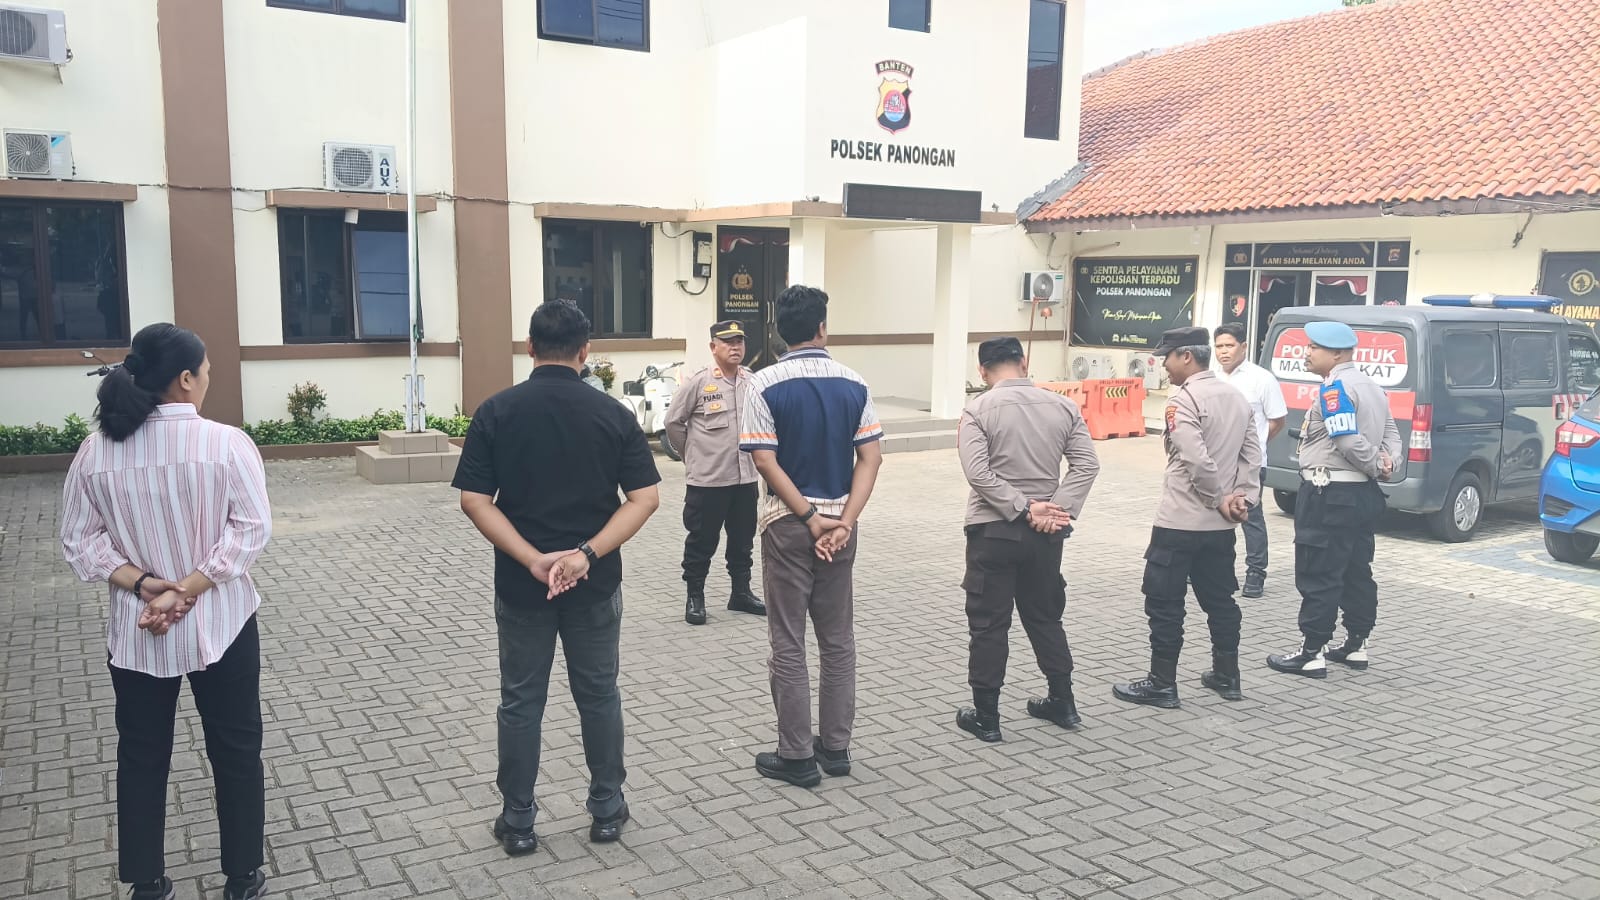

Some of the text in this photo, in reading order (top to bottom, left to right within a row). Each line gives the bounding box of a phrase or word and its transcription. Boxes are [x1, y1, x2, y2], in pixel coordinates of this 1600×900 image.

[879, 61, 912, 76] BANTEN
[831, 139, 956, 168] POLSEK PANONGAN
[380, 158, 390, 187] AUX
[1263, 257, 1366, 265] KAMI SIAP MELAYANI ANDA
[1093, 265, 1178, 275] SENTRA PELAYANAN
[1090, 275, 1180, 285] KEPOLISIAN TERPADU
[1096, 287, 1172, 297] POLSEK PANONGAN
